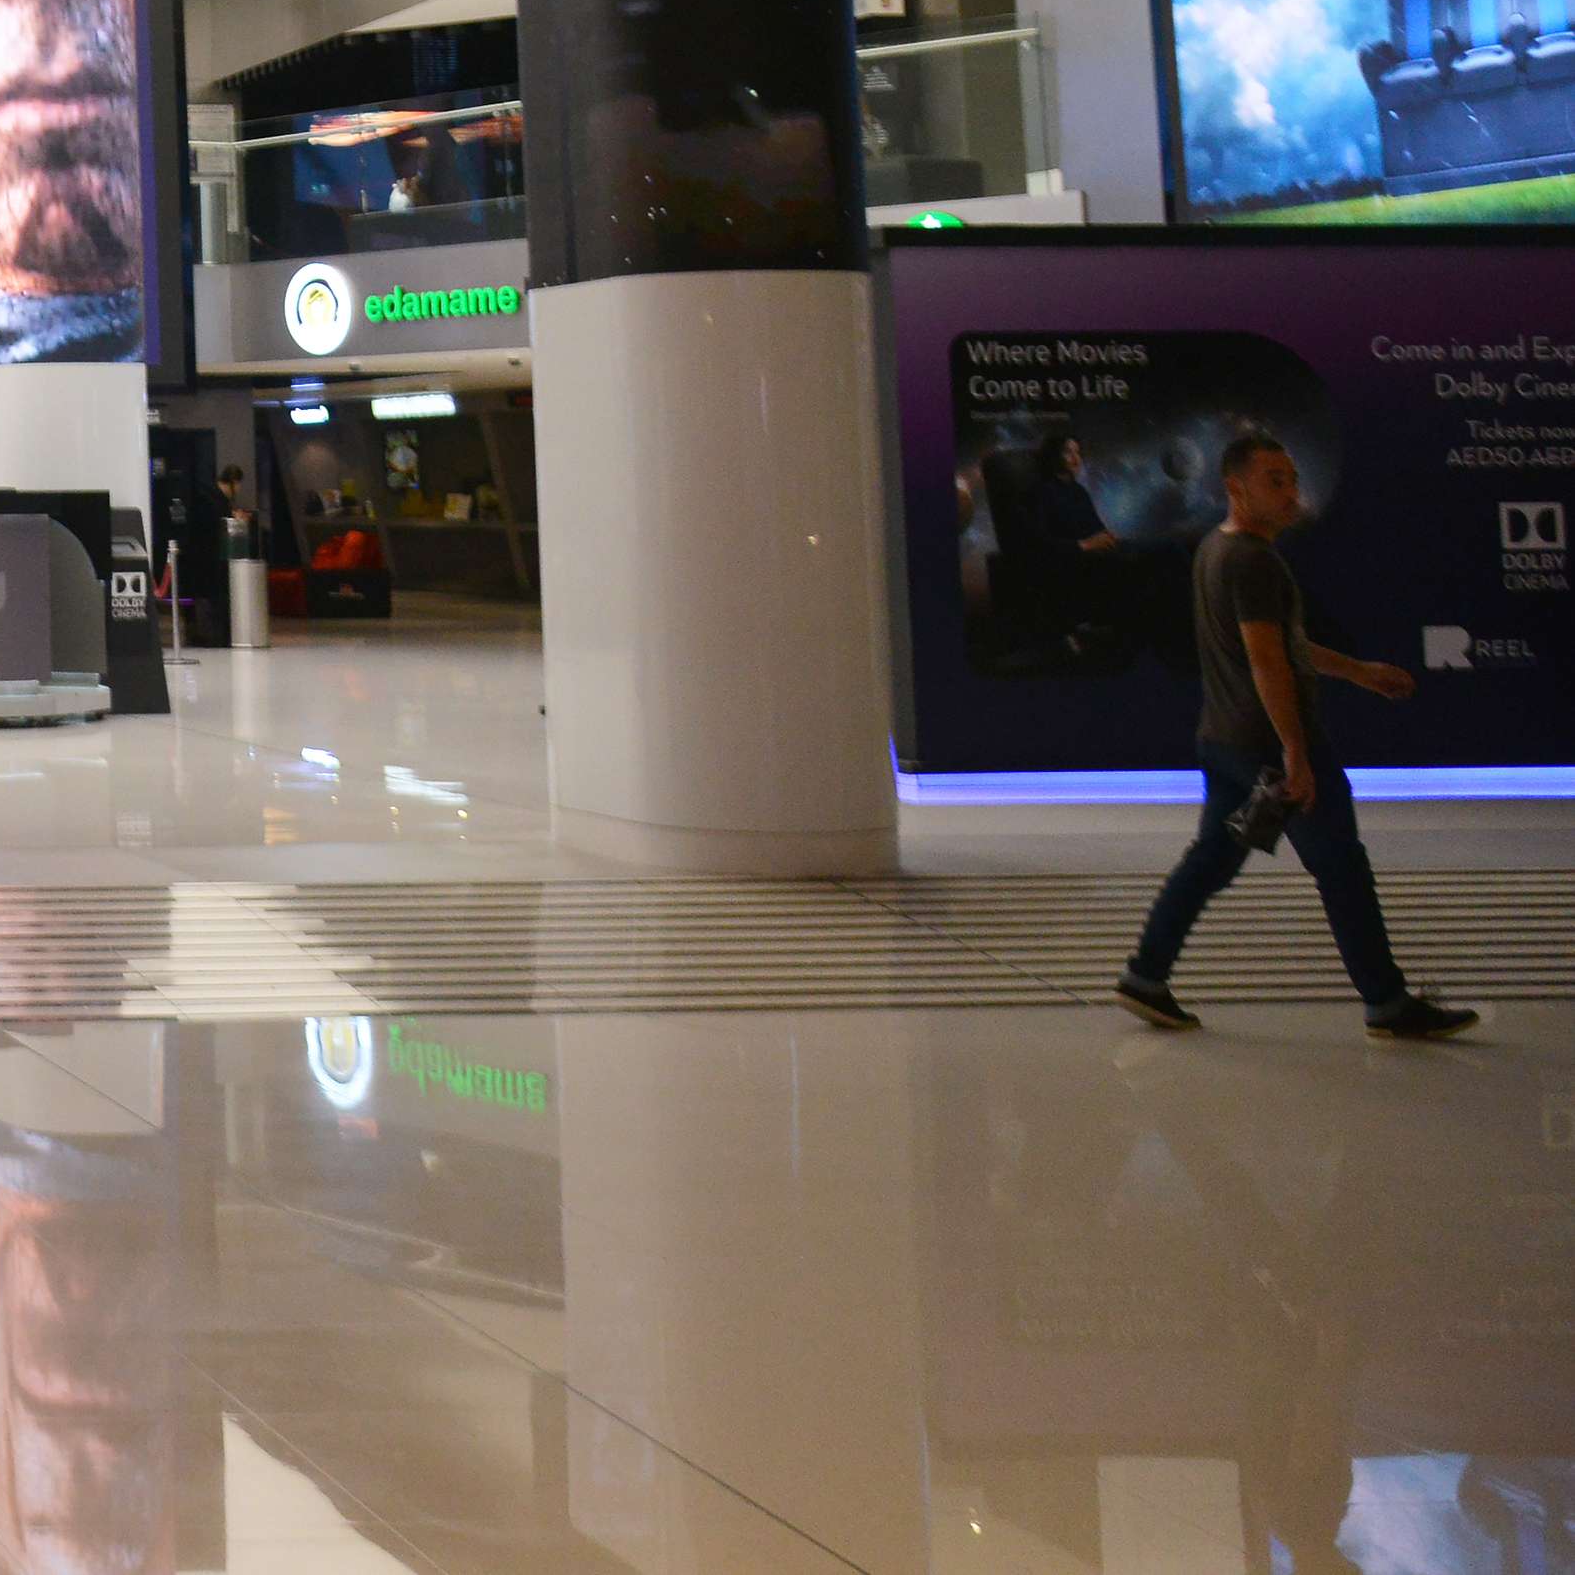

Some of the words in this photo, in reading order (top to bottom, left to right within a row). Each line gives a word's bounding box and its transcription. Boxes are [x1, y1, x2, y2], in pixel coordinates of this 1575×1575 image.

[364, 285, 521, 323] edamame
[965, 340, 1050, 364] Where
[1056, 340, 1148, 364] Movies
[1371, 335, 1446, 362] Come
[1451, 336, 1474, 361] in
[1478, 333, 1526, 361] and
[968, 375, 1042, 400] Come
[1048, 377, 1077, 400] to
[1081, 375, 1130, 400] Life
[1434, 371, 1508, 405] Dolby
[1502, 552, 1566, 569] DOLBY
[1475, 639, 1536, 657] REEL
